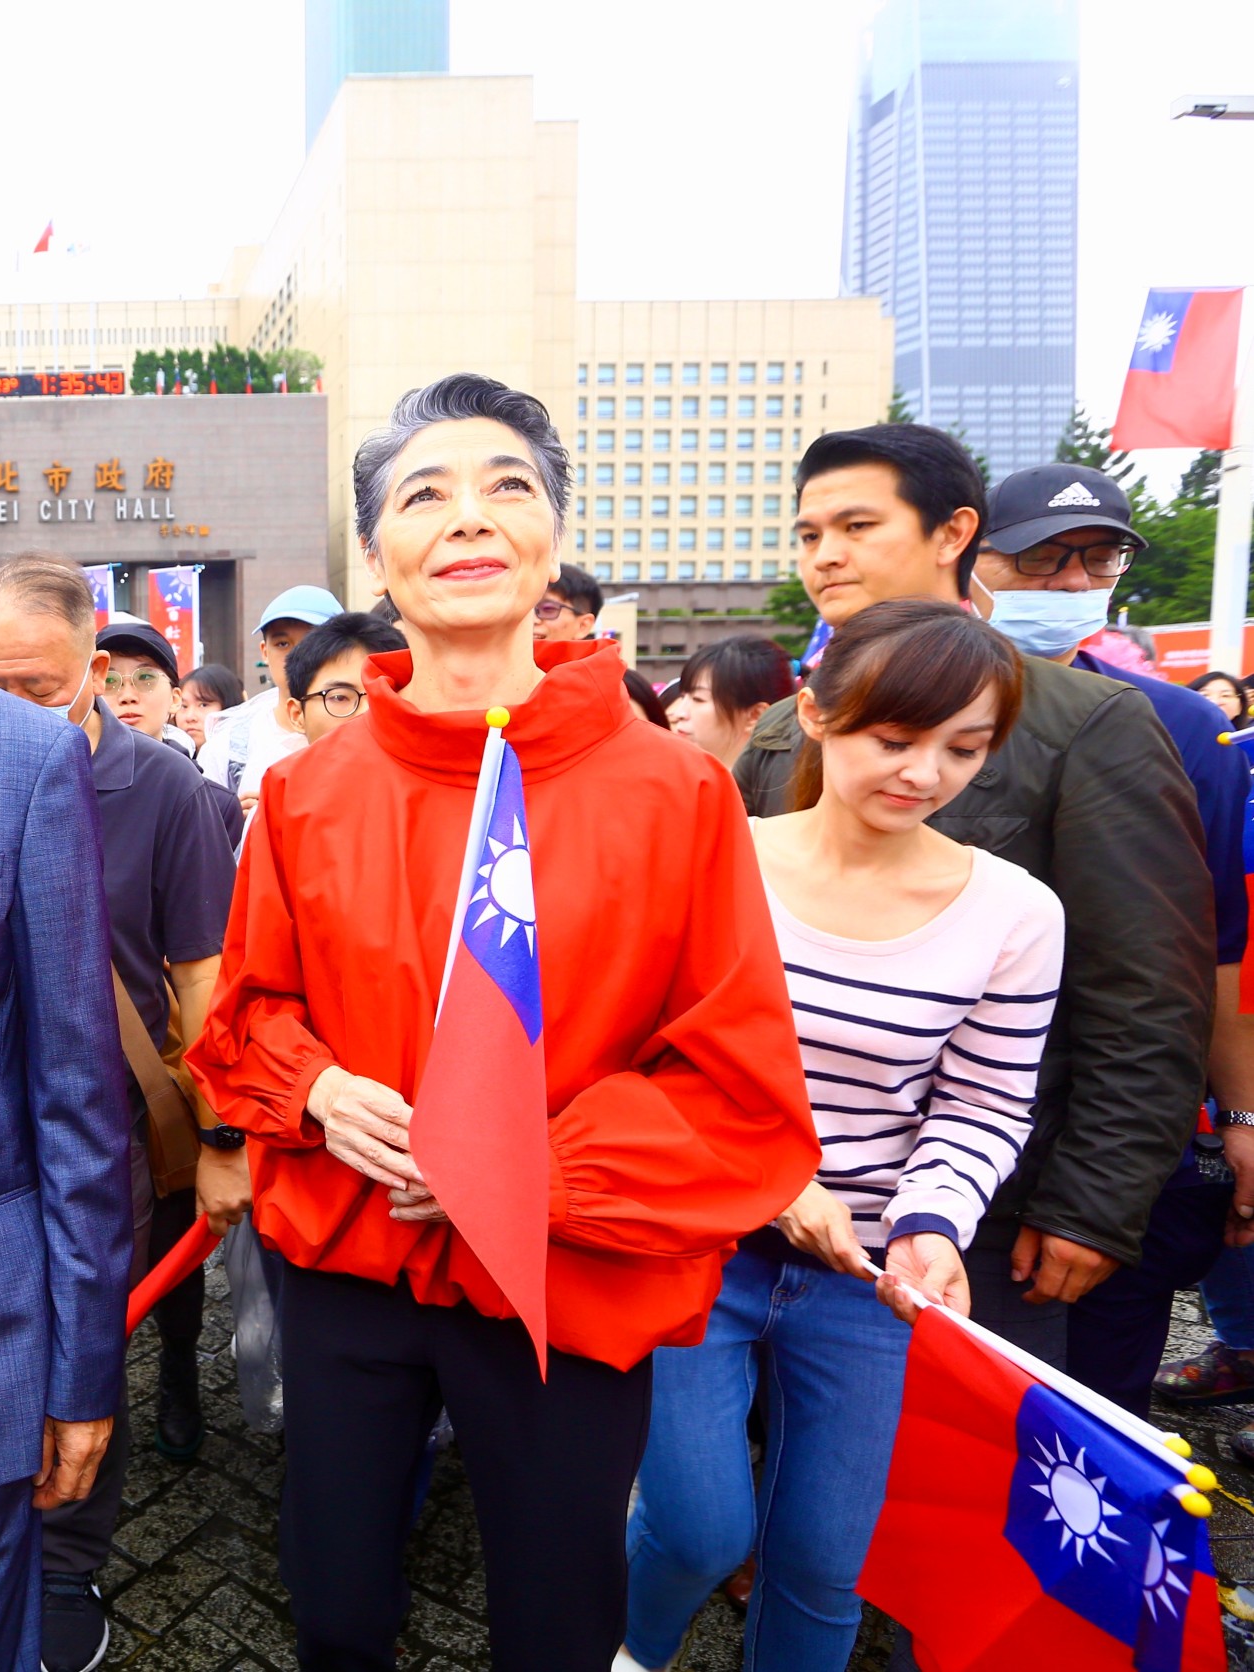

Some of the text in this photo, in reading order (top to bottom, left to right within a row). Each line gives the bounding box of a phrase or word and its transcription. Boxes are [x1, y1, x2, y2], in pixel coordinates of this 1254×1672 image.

[39, 498, 95, 521] CITY
[115, 496, 176, 520] HALL
[1047, 498, 1101, 507] adidas
